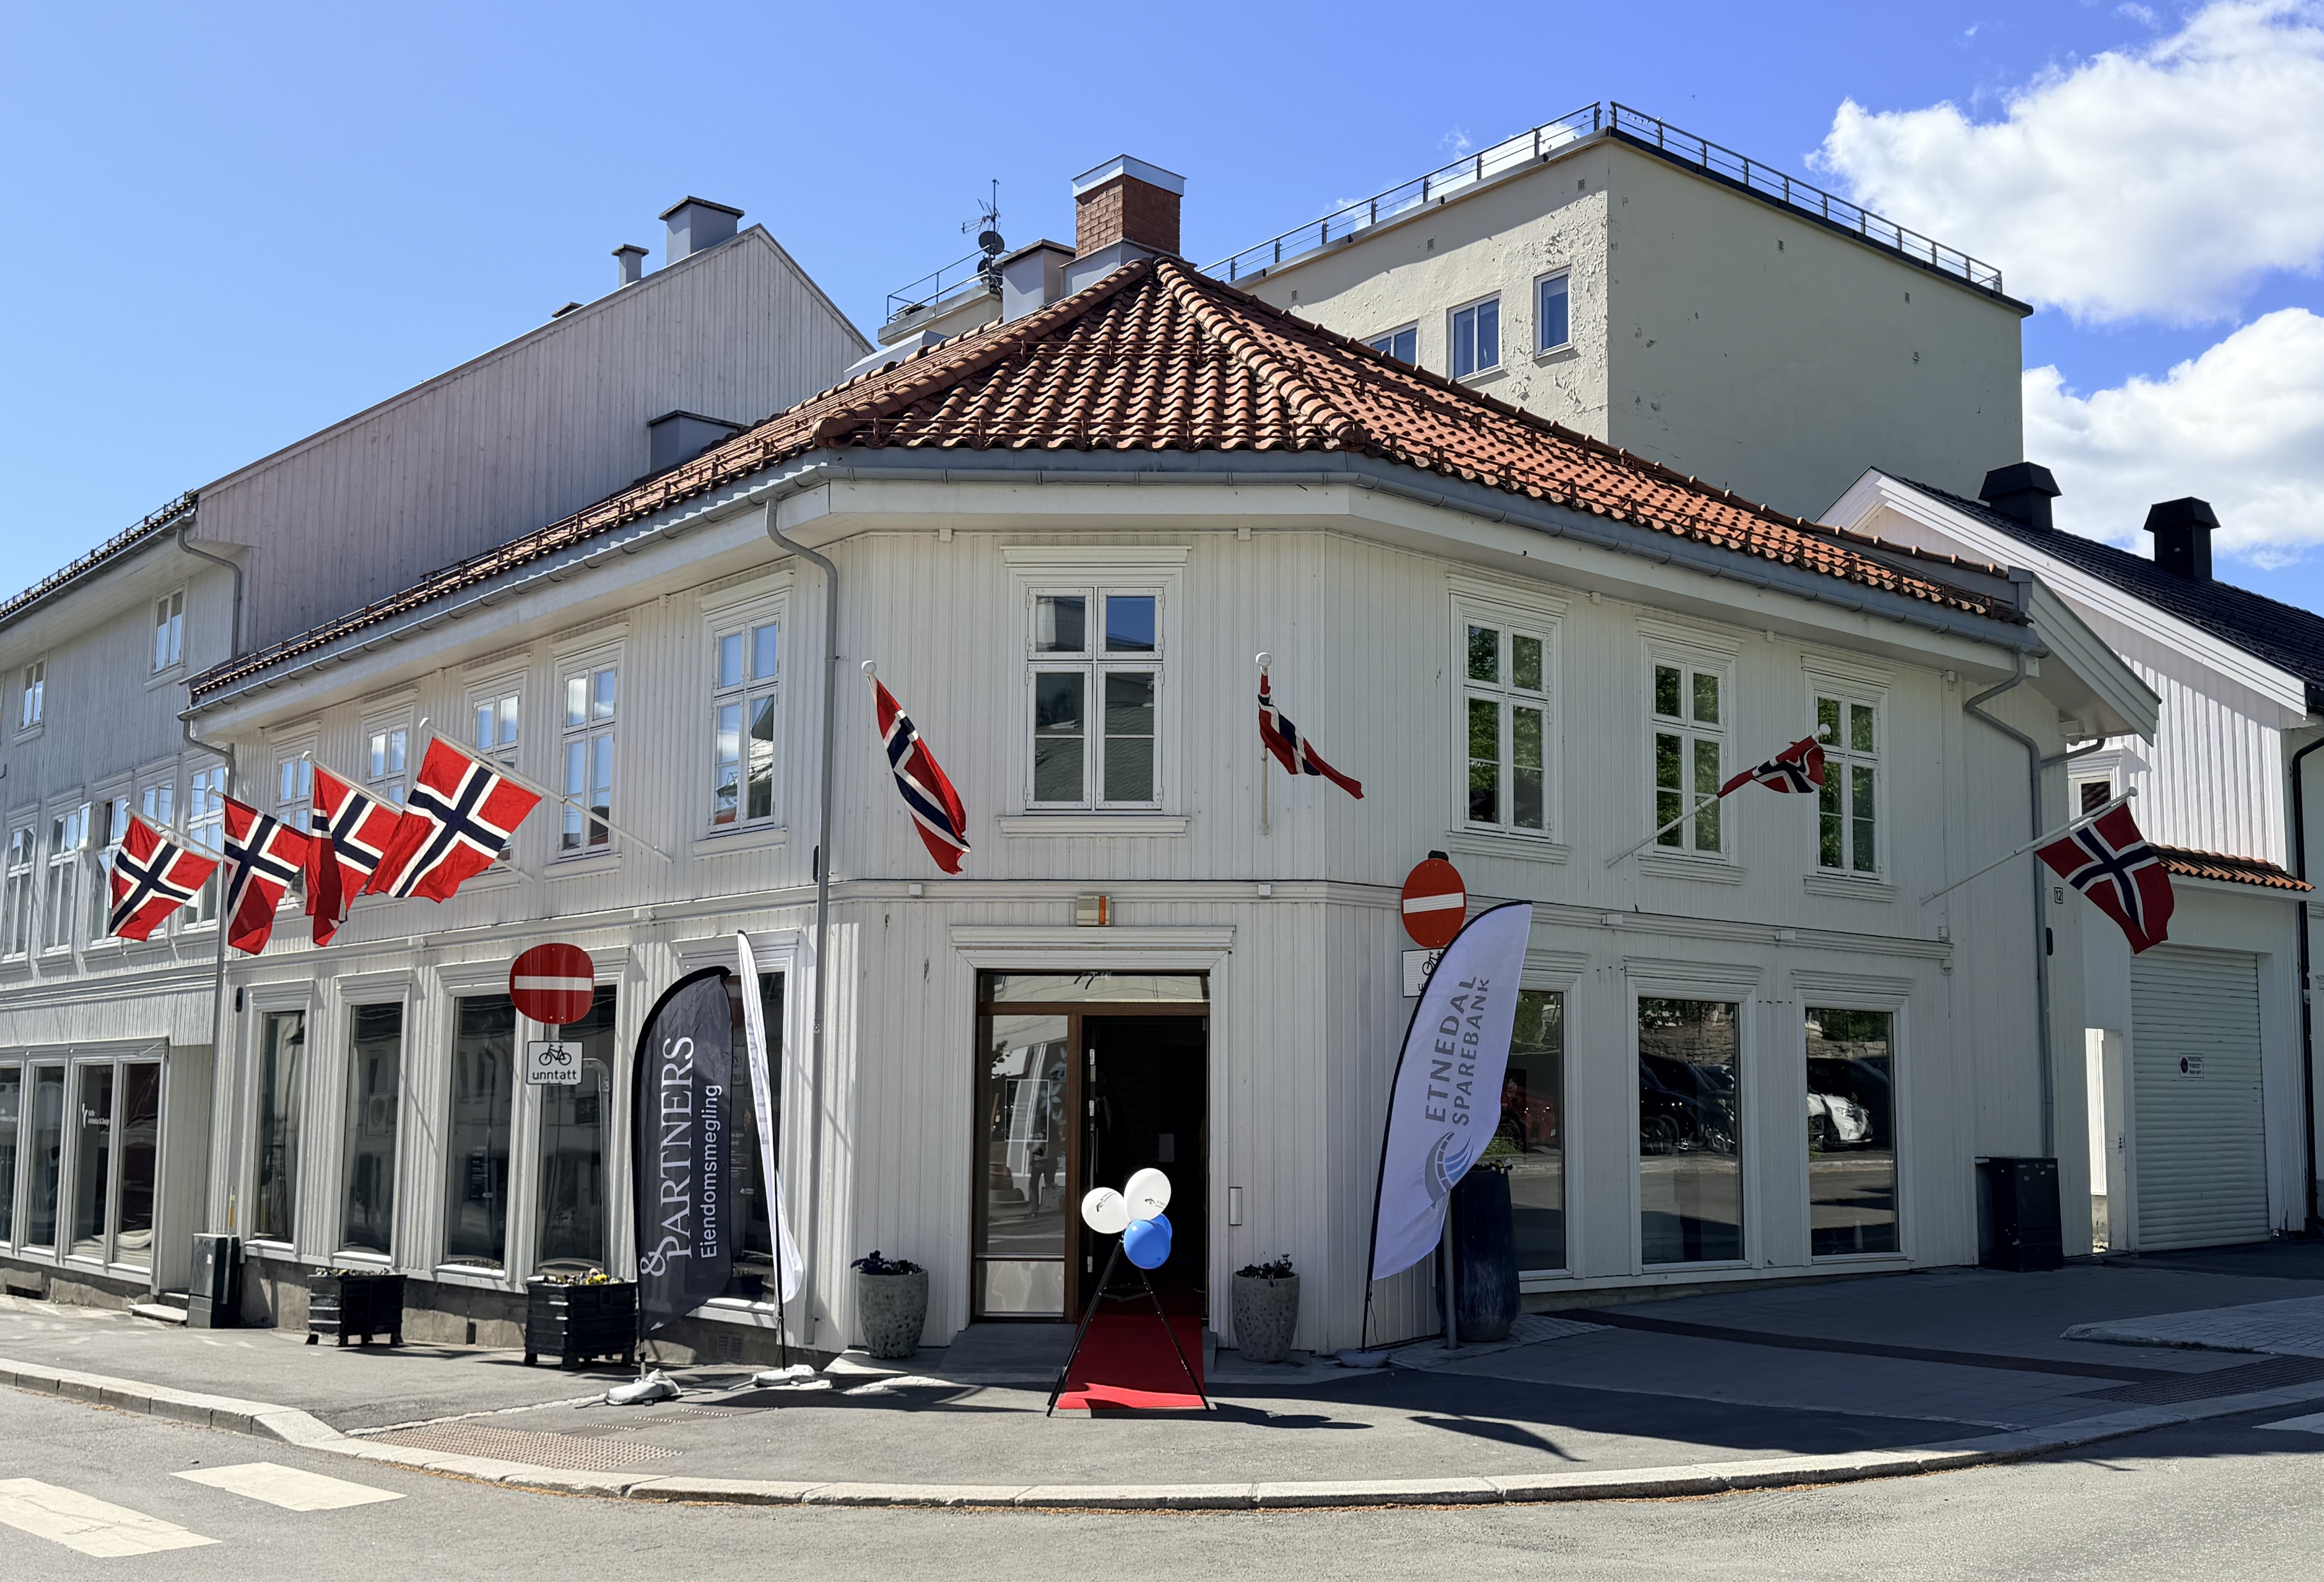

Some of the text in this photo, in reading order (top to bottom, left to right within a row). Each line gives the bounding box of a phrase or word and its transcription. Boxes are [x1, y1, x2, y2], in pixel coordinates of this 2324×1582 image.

[532, 1070, 577, 1080] unntatt
[1425, 977, 1477, 1122] ETNEDAL
[1452, 978, 1490, 1126] SPAREBANK
[699, 1085, 722, 1259] Eiendomsmegling
